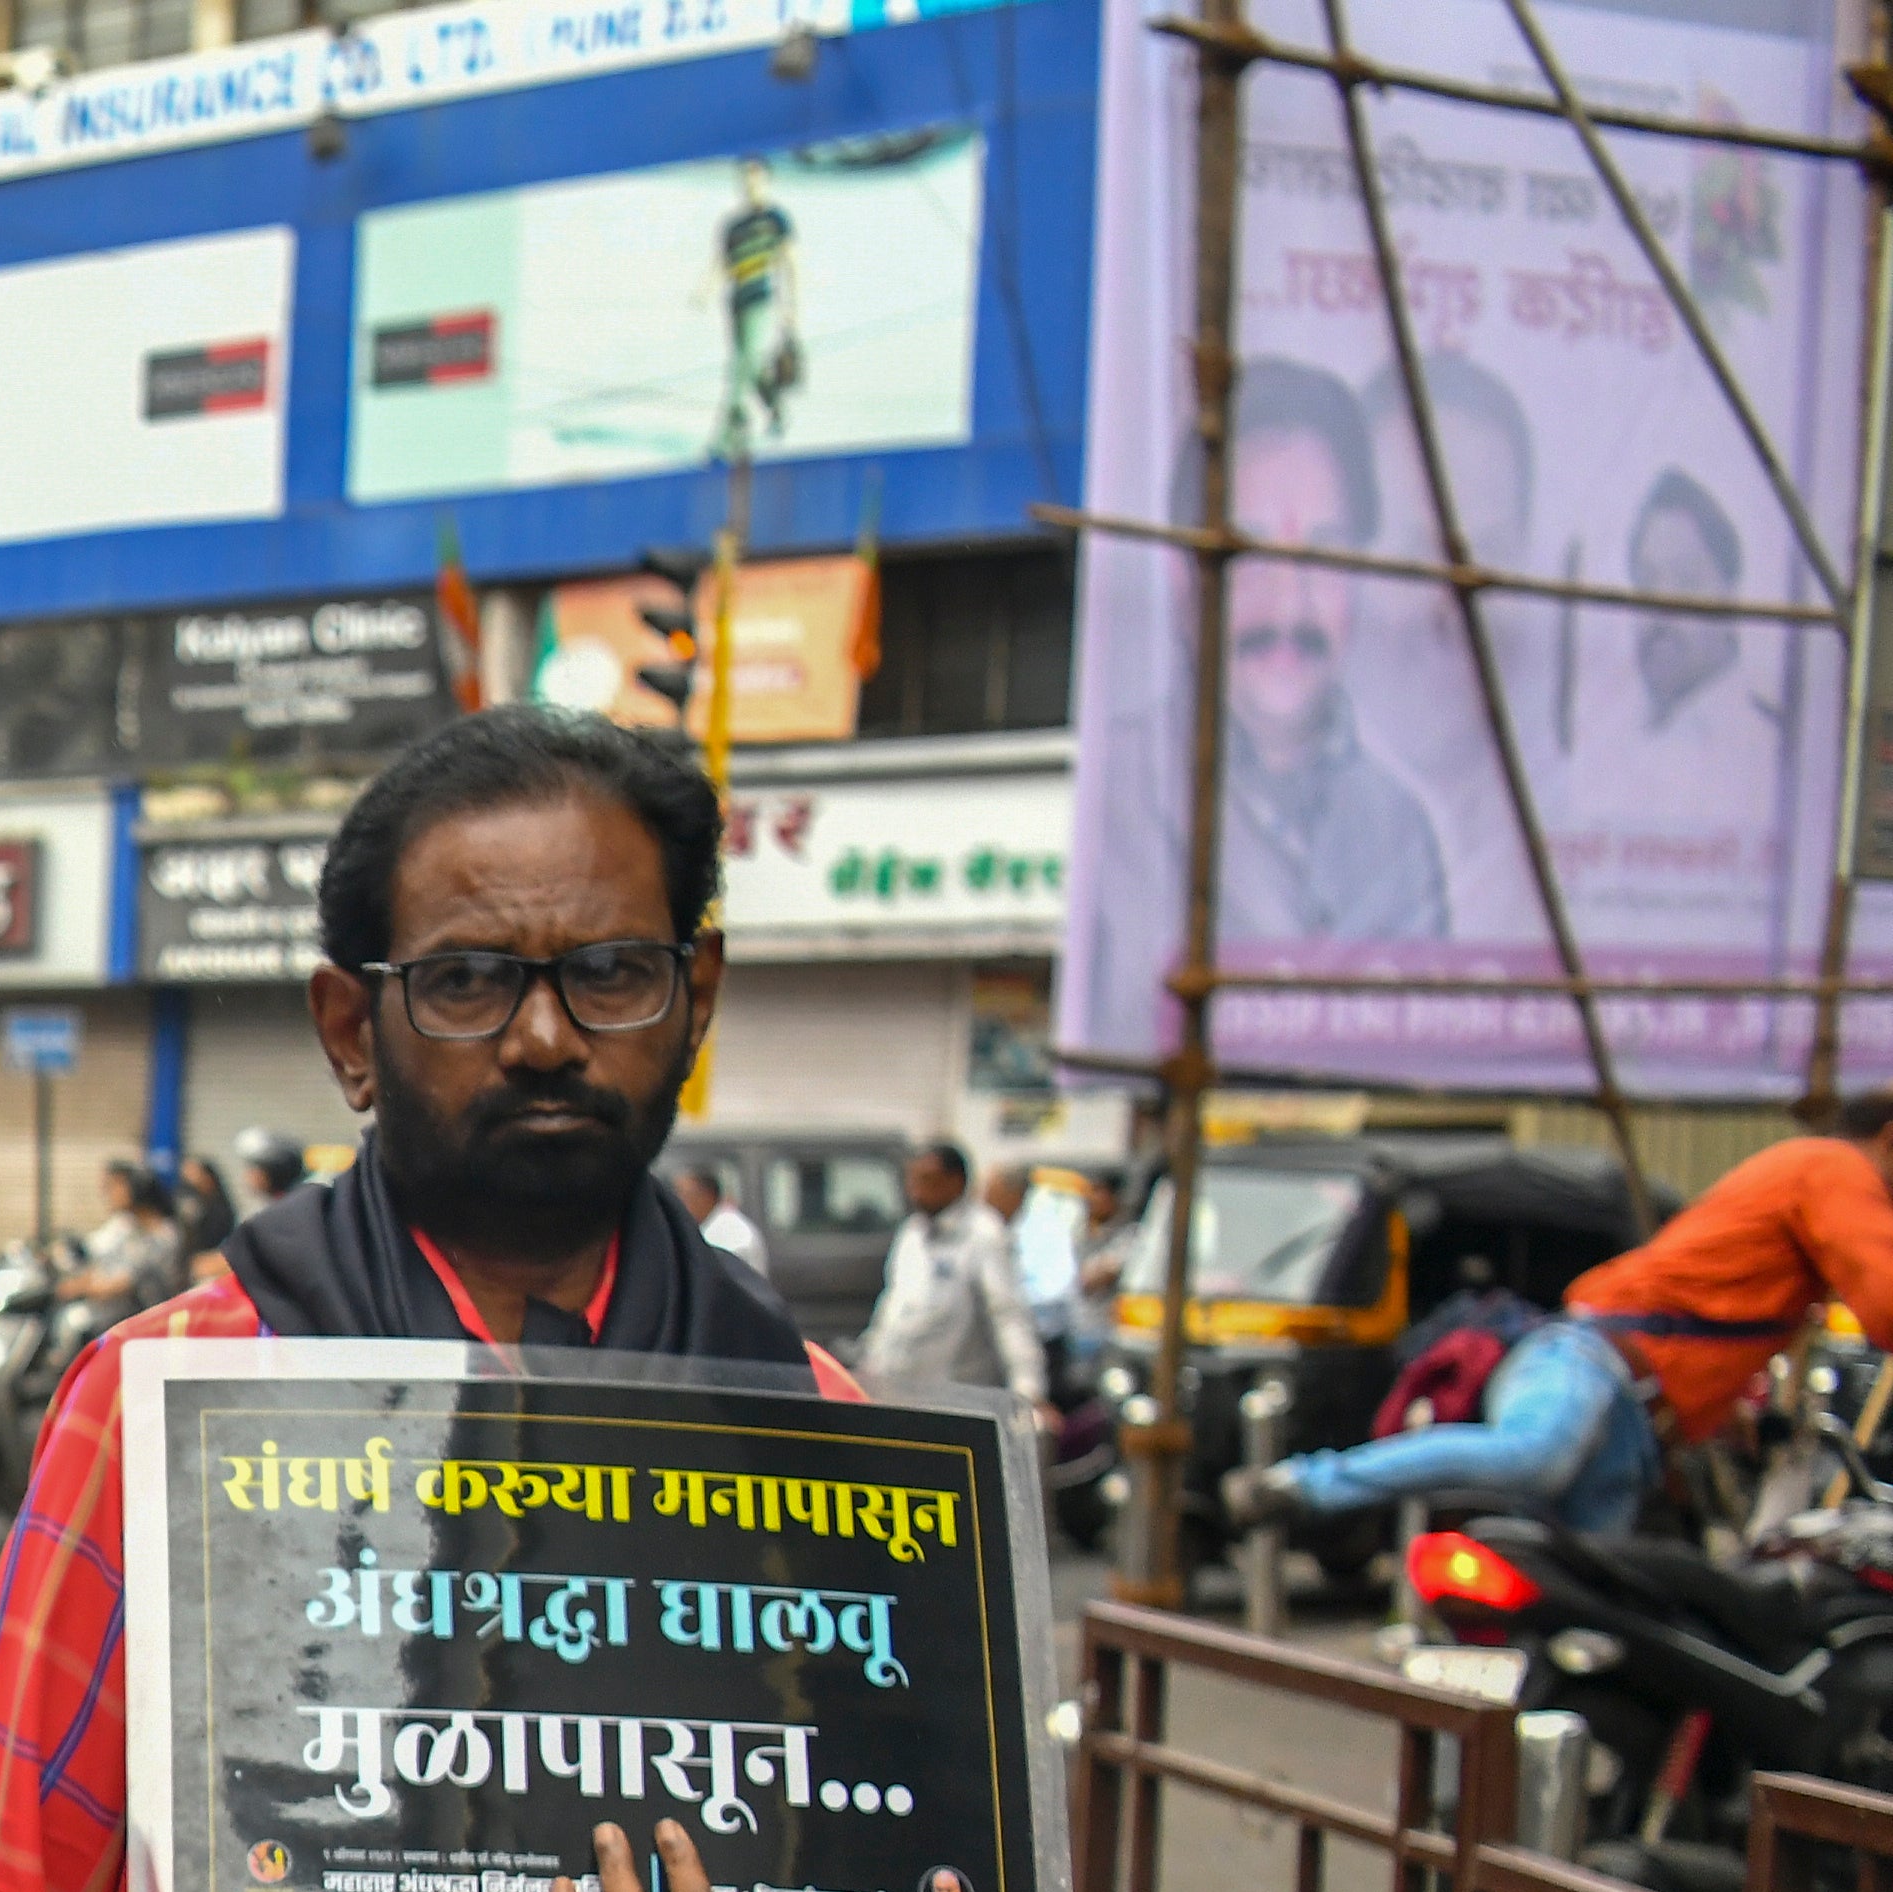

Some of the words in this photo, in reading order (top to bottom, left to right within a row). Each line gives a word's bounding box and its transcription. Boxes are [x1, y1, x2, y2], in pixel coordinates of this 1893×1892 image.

[61, 57, 298, 148] INSURANCE
[313, 599, 427, 653] Clinic
[221, 1437, 393, 1512] संघर्ष
[650, 1467, 961, 1563] मनापासून
[305, 1547, 637, 1665] अंधश्रद्धा
[652, 1578, 911, 1689] घालवू
[297, 1705, 914, 1836] मुळापासून...
